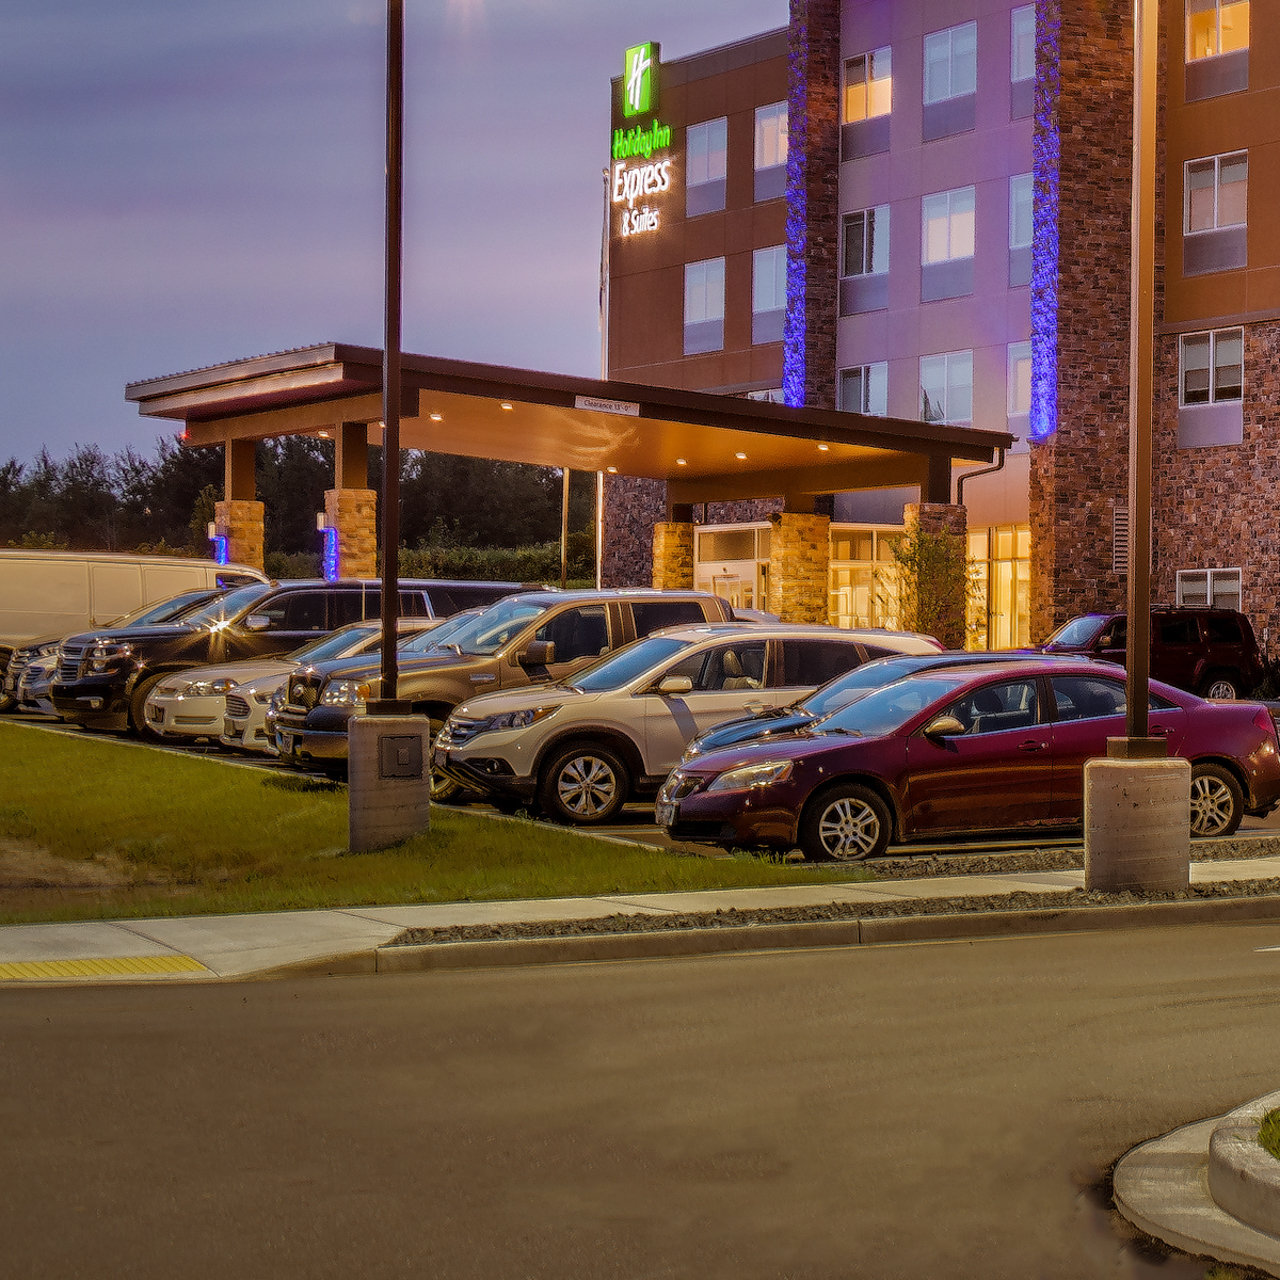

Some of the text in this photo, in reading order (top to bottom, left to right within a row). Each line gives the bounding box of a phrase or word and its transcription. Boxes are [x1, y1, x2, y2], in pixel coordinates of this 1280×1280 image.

[612, 119, 671, 160] Holiday Inn
[613, 160, 671, 208] Express
[622, 206, 659, 237] & Suites
[583, 399, 612, 410] Clearance
